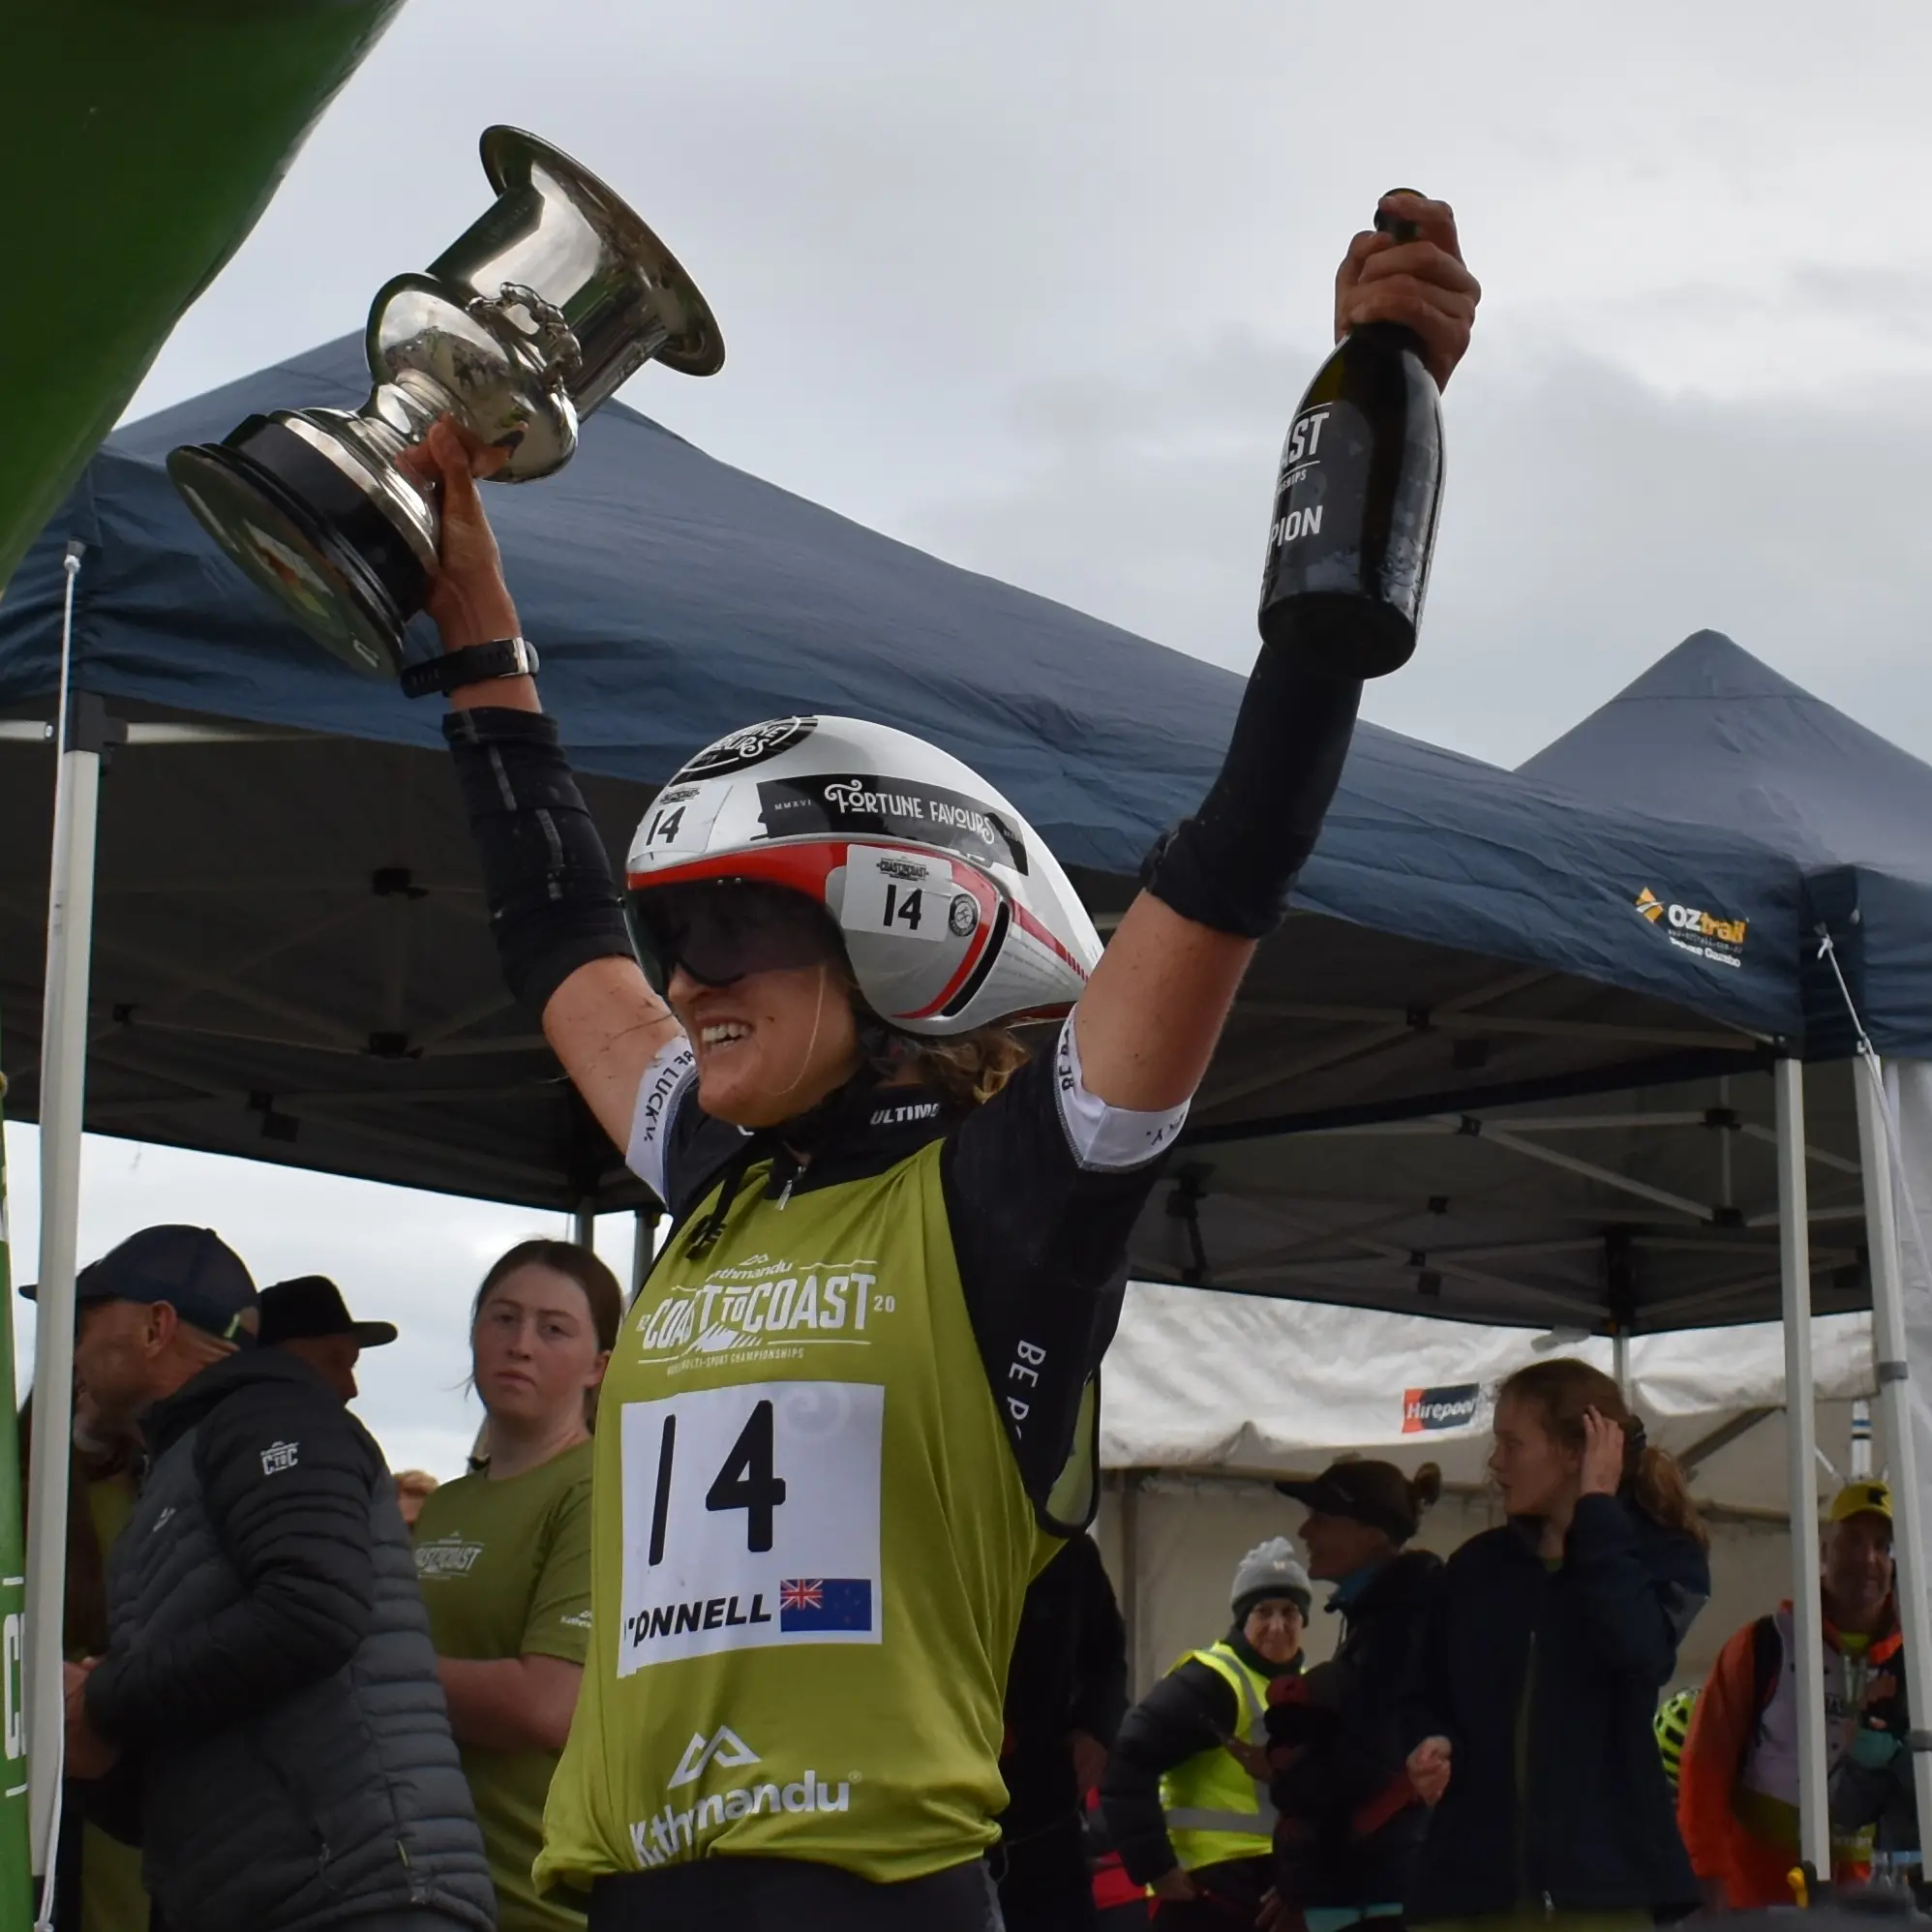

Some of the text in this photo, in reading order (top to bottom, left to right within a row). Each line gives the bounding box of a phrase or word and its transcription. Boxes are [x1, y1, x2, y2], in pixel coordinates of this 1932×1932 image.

[646, 805, 687, 846] 14
[824, 779, 995, 845] FORTUNE FAVOURS
[883, 884, 922, 930] 14
[721, 1296, 749, 1323] TO
[741, 1272, 876, 1333] COAST
[874, 1295, 895, 1313] 20
[1009, 1340, 1046, 1388] BE
[648, 1400, 786, 1567] 14
[629, 1769, 850, 1867] Kthmandu
